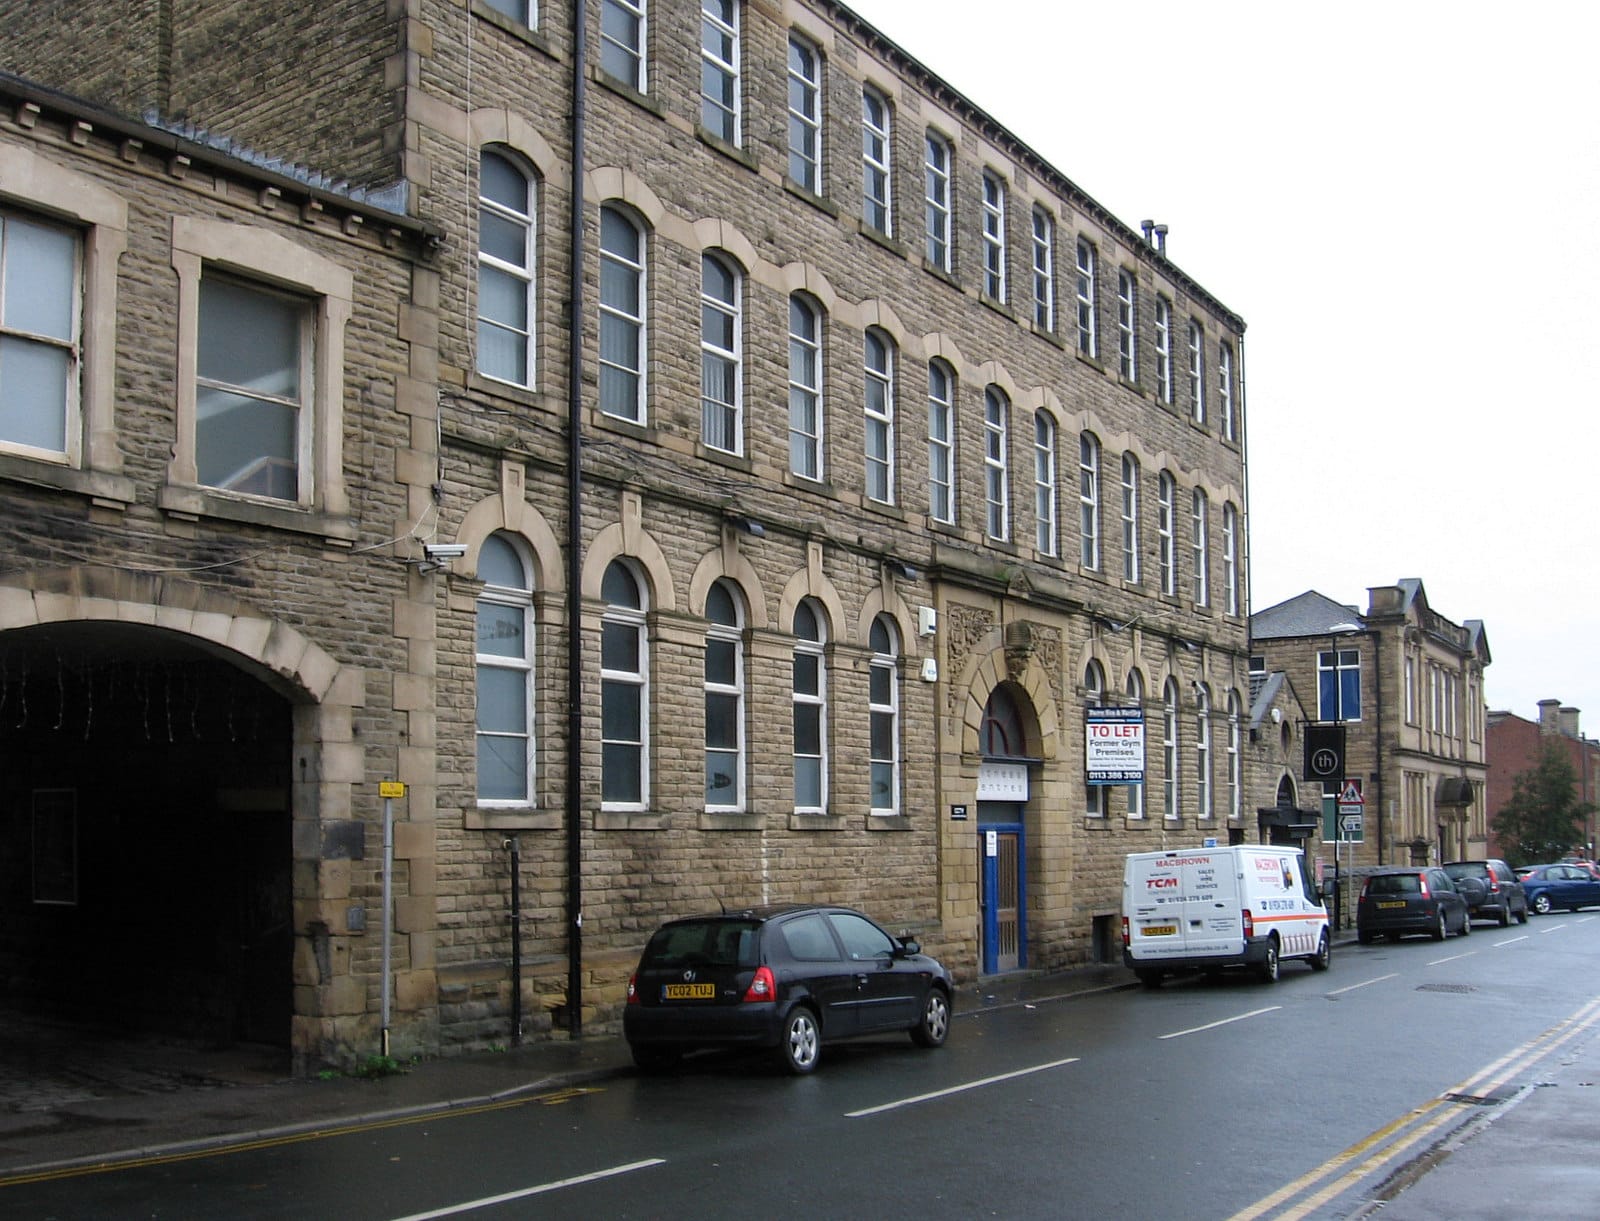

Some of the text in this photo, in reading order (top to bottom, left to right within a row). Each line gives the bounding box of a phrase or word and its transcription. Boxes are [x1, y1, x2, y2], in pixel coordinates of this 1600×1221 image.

[1090, 725, 1140, 737] TO LET
[1089, 739, 1141, 749] Former Gym
[1095, 748, 1135, 756] Premises
[1155, 856, 1210, 867] MACBROWN
[1146, 878, 1177, 889] TCM
[667, 985, 692, 997] YC02
[693, 985, 713, 996] TUJ
